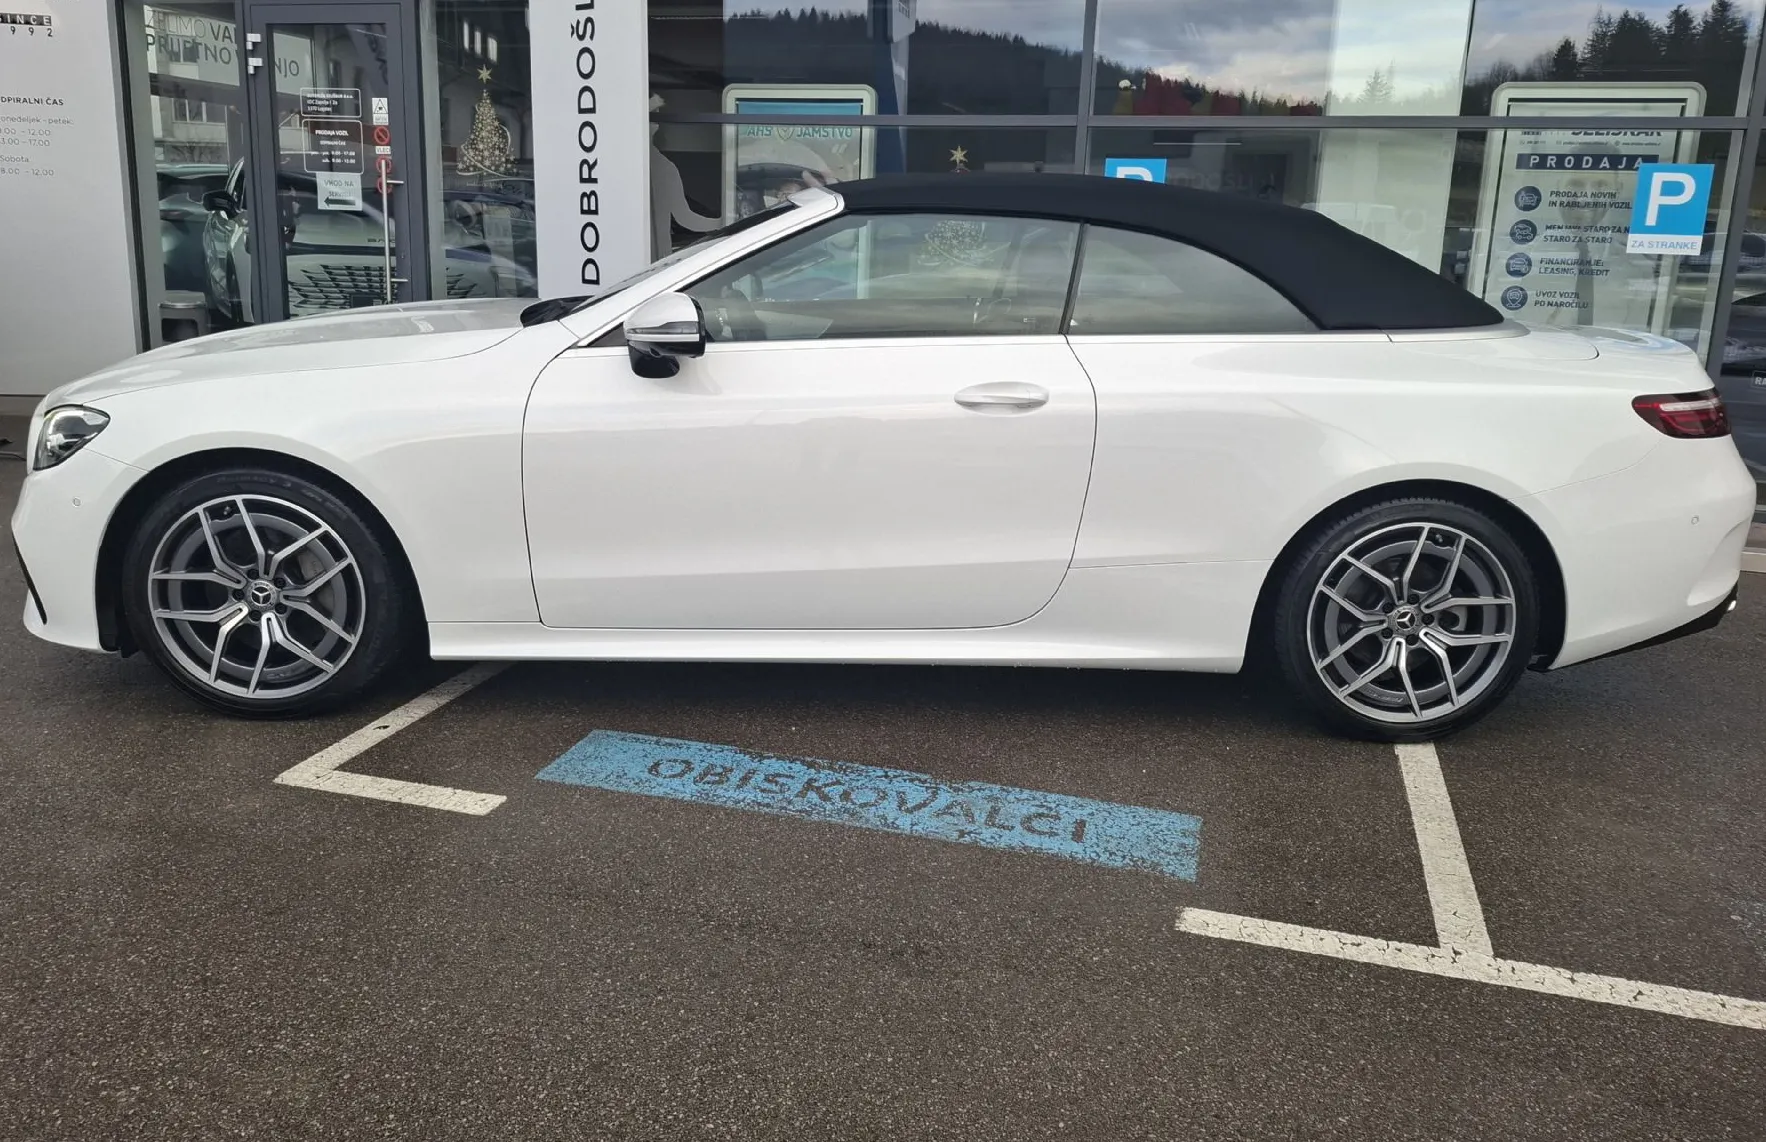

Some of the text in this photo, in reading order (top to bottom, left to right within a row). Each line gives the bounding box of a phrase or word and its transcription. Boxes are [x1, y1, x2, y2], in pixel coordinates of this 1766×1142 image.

[0, 14, 51, 26] INCE
[209, 22, 237, 43] VA
[45, 96, 64, 106] ČAS
[1529, 156, 1642, 169] PRODAJA
[1550, 190, 1588, 199] PRODAJA
[1645, 172, 1697, 227] P
[1559, 201, 1607, 209] RABLJENIH
[1584, 236, 1613, 244] STARO
[1631, 240, 1698, 250] ZA STRANKE
[1578, 269, 1610, 277] KREDIT
[646, 757, 1087, 845] OBISKOVALCI
